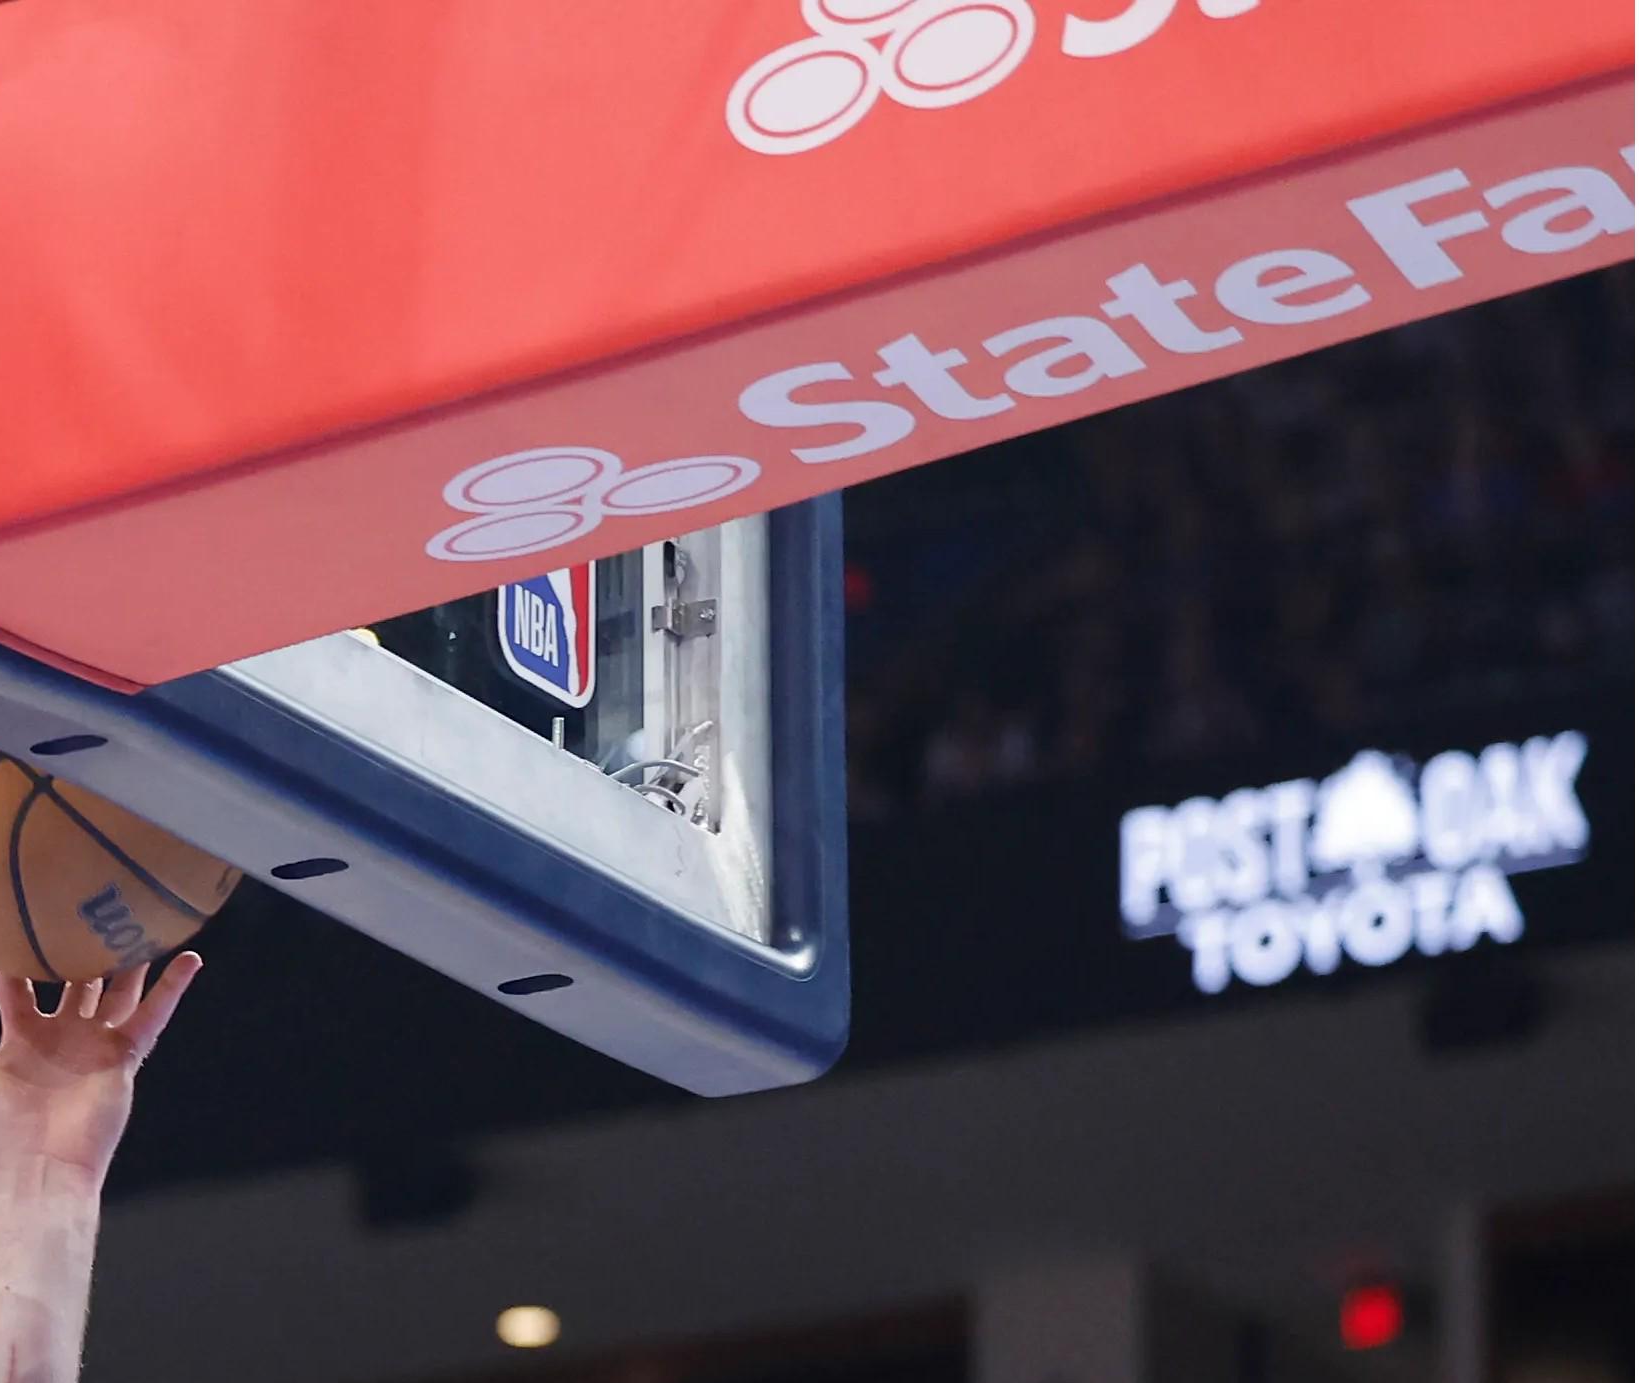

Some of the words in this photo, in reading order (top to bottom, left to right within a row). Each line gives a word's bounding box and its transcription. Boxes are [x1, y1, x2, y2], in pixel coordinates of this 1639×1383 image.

[514, 583, 560, 668] NBA
[1120, 777, 1321, 926] POST
[1419, 730, 1591, 868] OAK
[1176, 863, 1524, 994] TOYOTA
